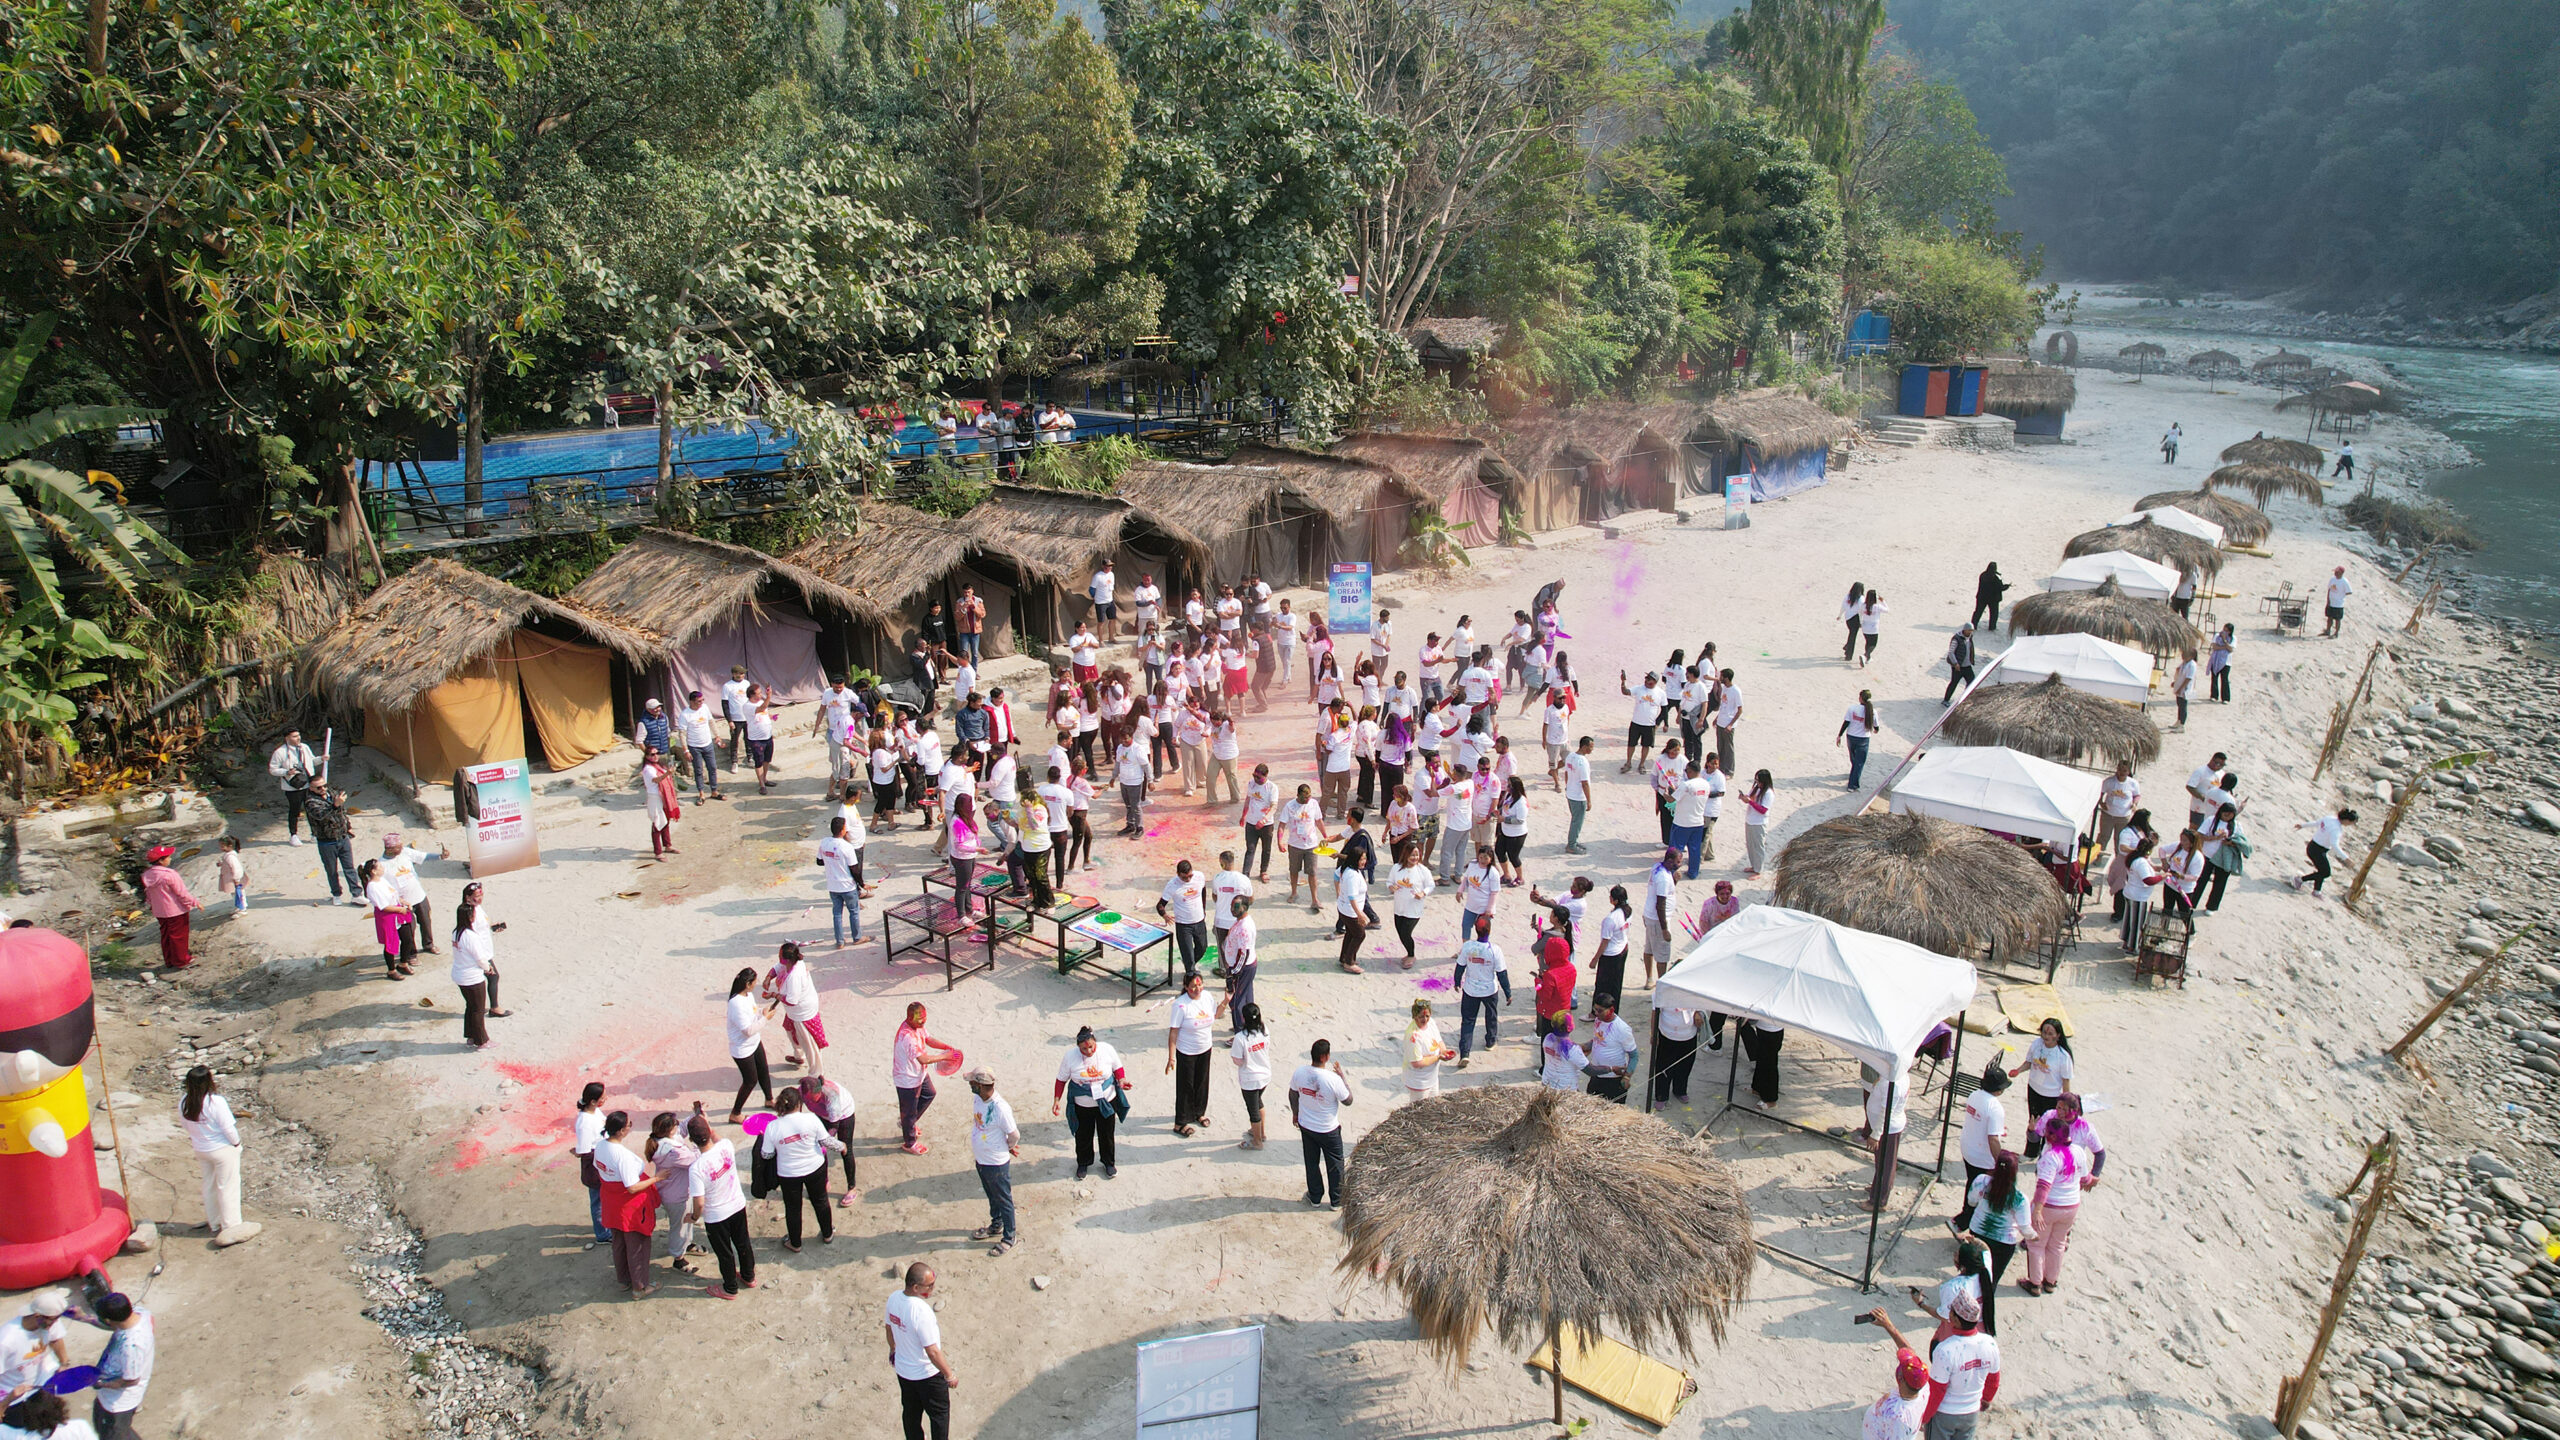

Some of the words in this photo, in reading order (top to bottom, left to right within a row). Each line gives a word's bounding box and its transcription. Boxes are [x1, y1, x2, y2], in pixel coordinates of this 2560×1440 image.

[1340, 595, 1359, 603] BIG
[481, 807, 499, 820] 0%
[479, 830, 499, 842] 90%
